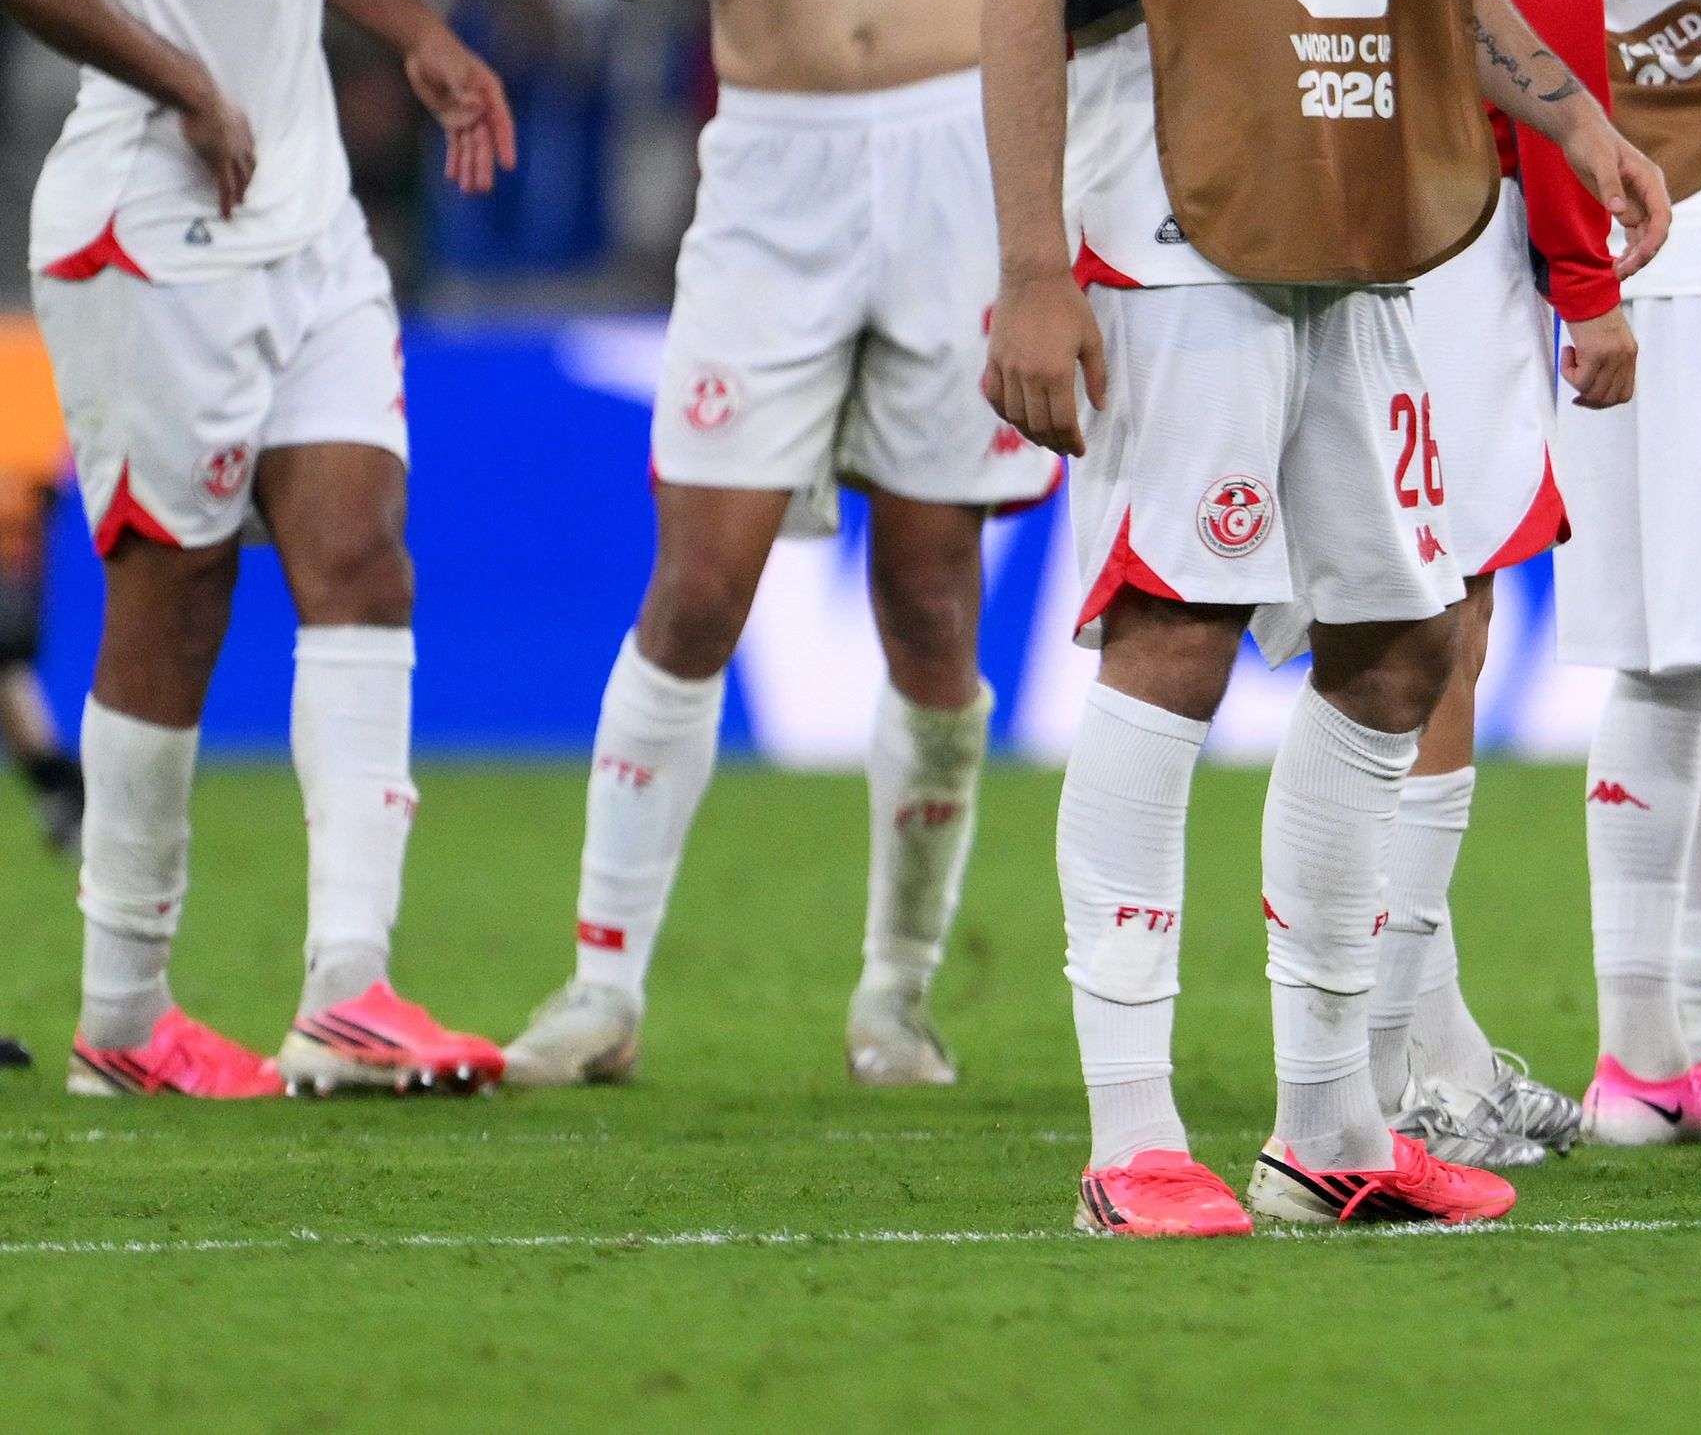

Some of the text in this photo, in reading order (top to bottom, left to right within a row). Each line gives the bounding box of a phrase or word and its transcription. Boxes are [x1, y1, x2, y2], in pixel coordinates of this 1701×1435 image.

[1290, 32, 1356, 64] WORLD
[1297, 69, 1395, 119] 2026
[1390, 393, 1444, 508] 26
